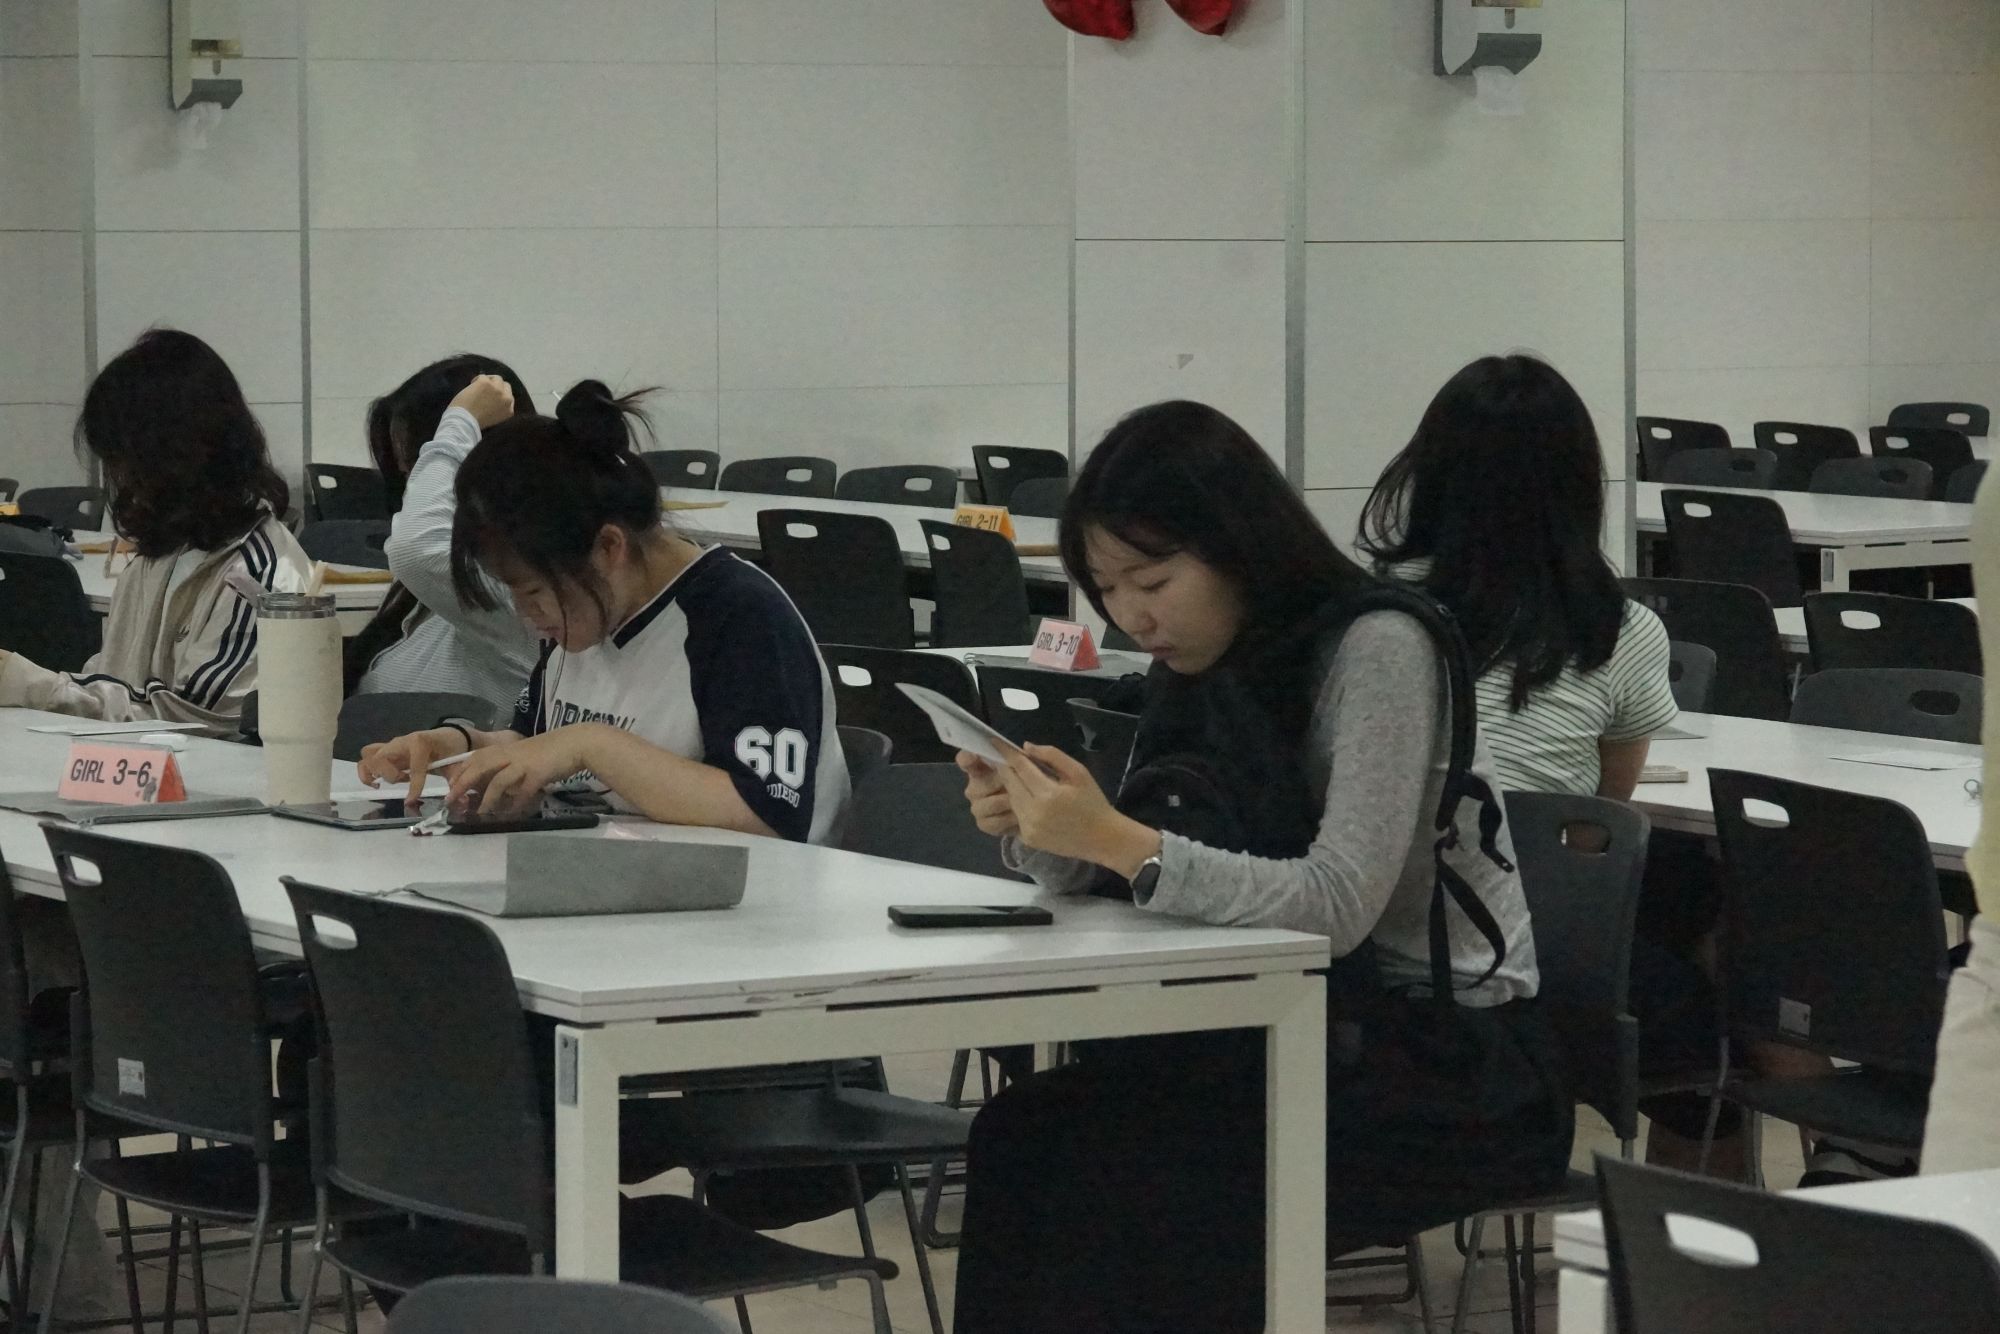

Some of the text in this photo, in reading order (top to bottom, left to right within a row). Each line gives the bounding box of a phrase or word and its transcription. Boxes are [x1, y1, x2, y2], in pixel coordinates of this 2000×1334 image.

[976, 513, 999, 530] 2-11
[1037, 631, 1080, 655] GIRL 3-10
[734, 725, 809, 790] 60
[70, 758, 152, 788] GIRL 3-6
